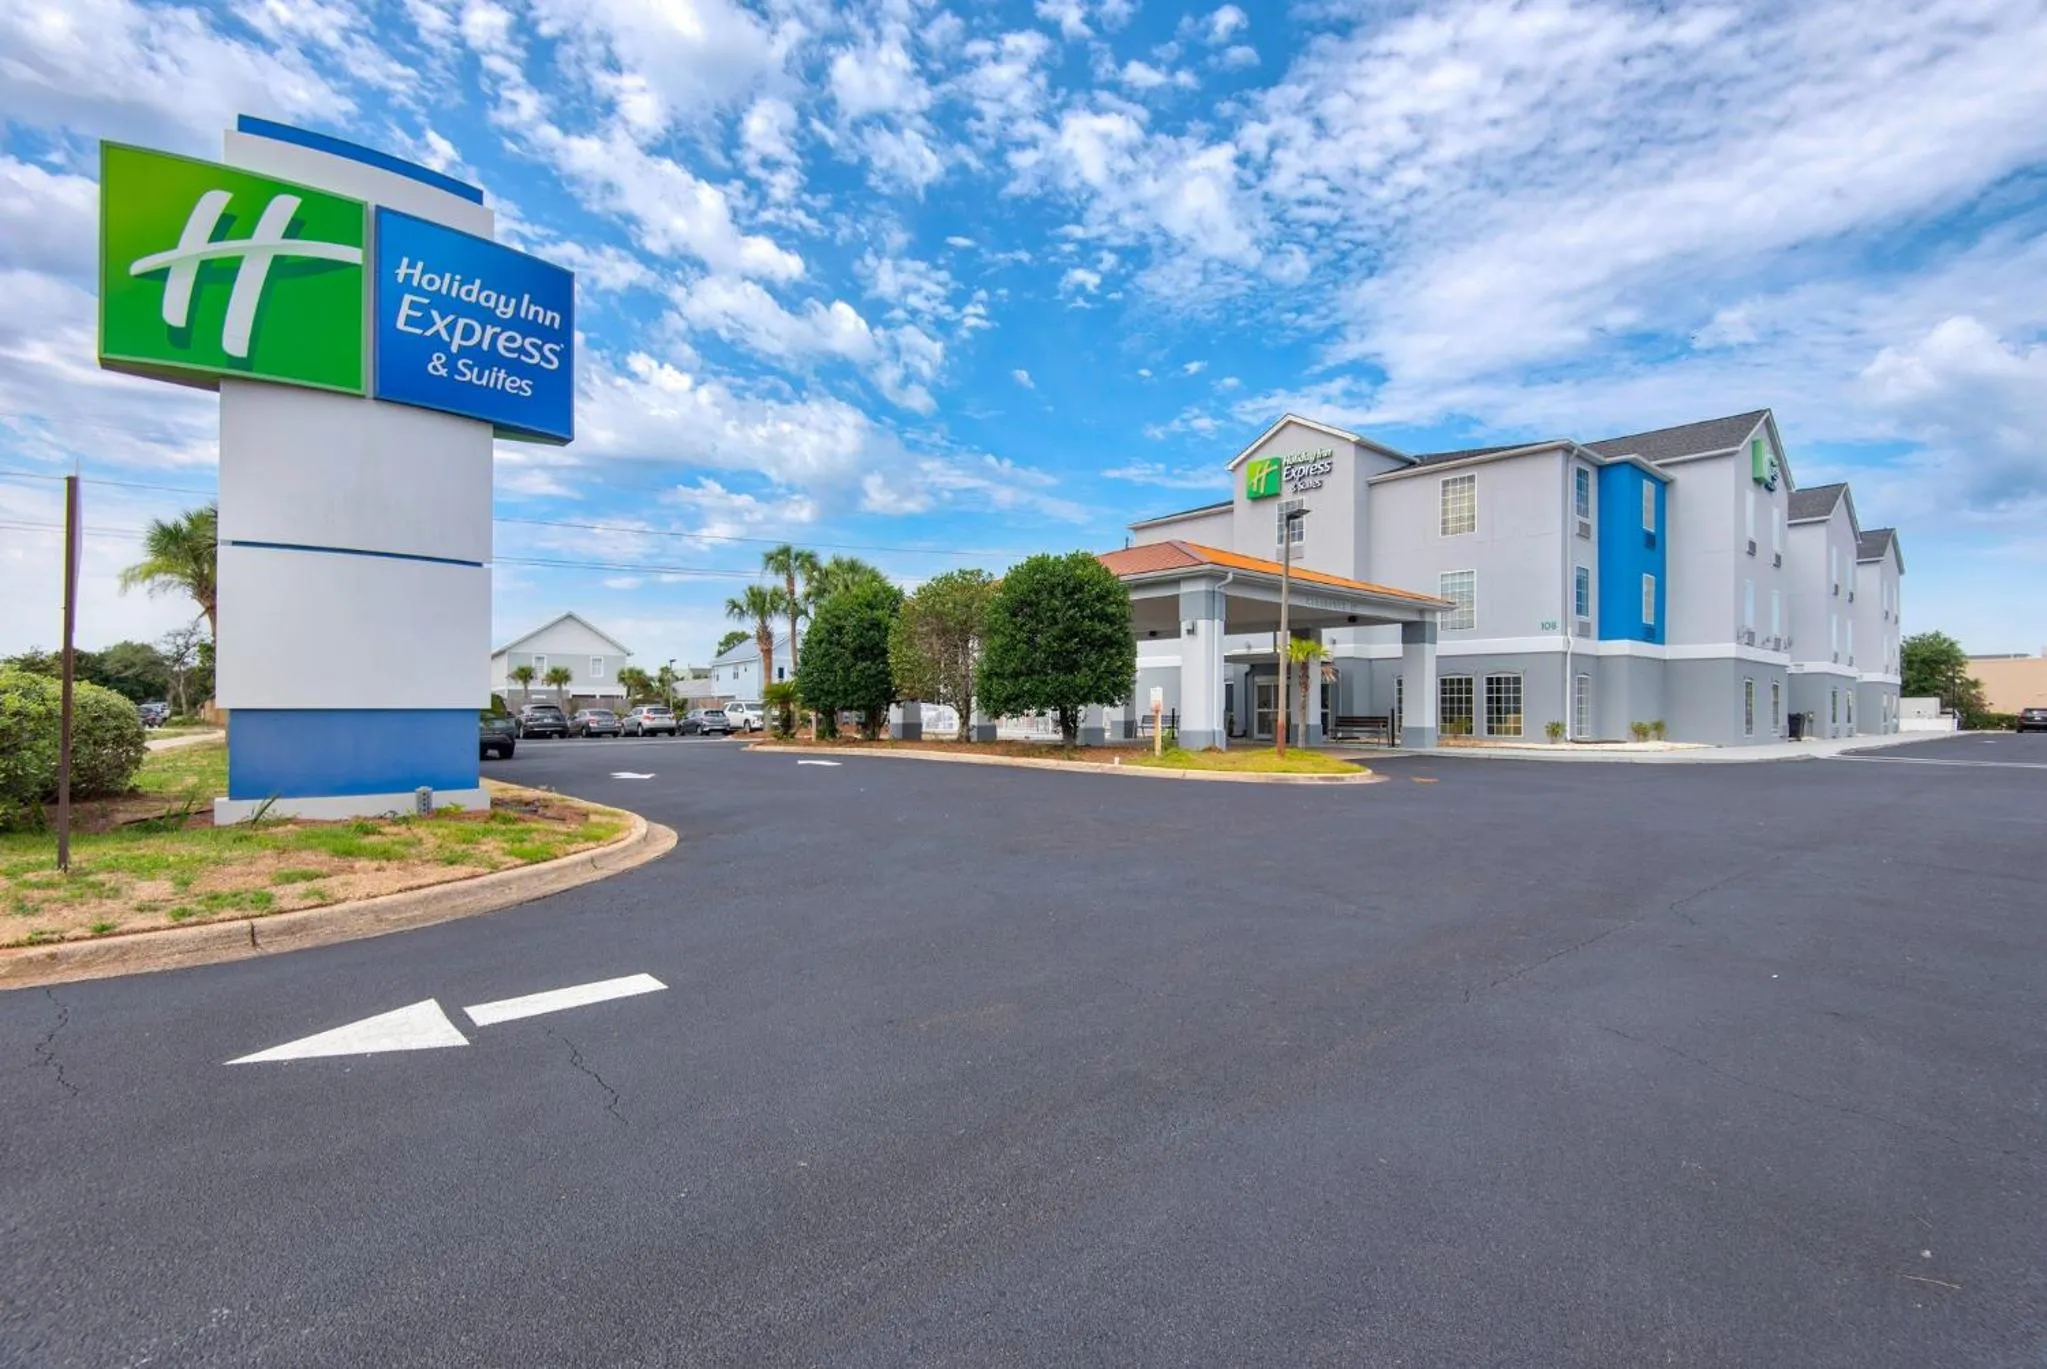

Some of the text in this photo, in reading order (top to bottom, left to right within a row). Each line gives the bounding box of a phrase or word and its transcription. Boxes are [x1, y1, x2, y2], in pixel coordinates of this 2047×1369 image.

[395, 256, 561, 330] Holiday Inn
[395, 293, 562, 371] Express
[427, 352, 534, 397] & Suites
[1282, 460, 1333, 482] Express
